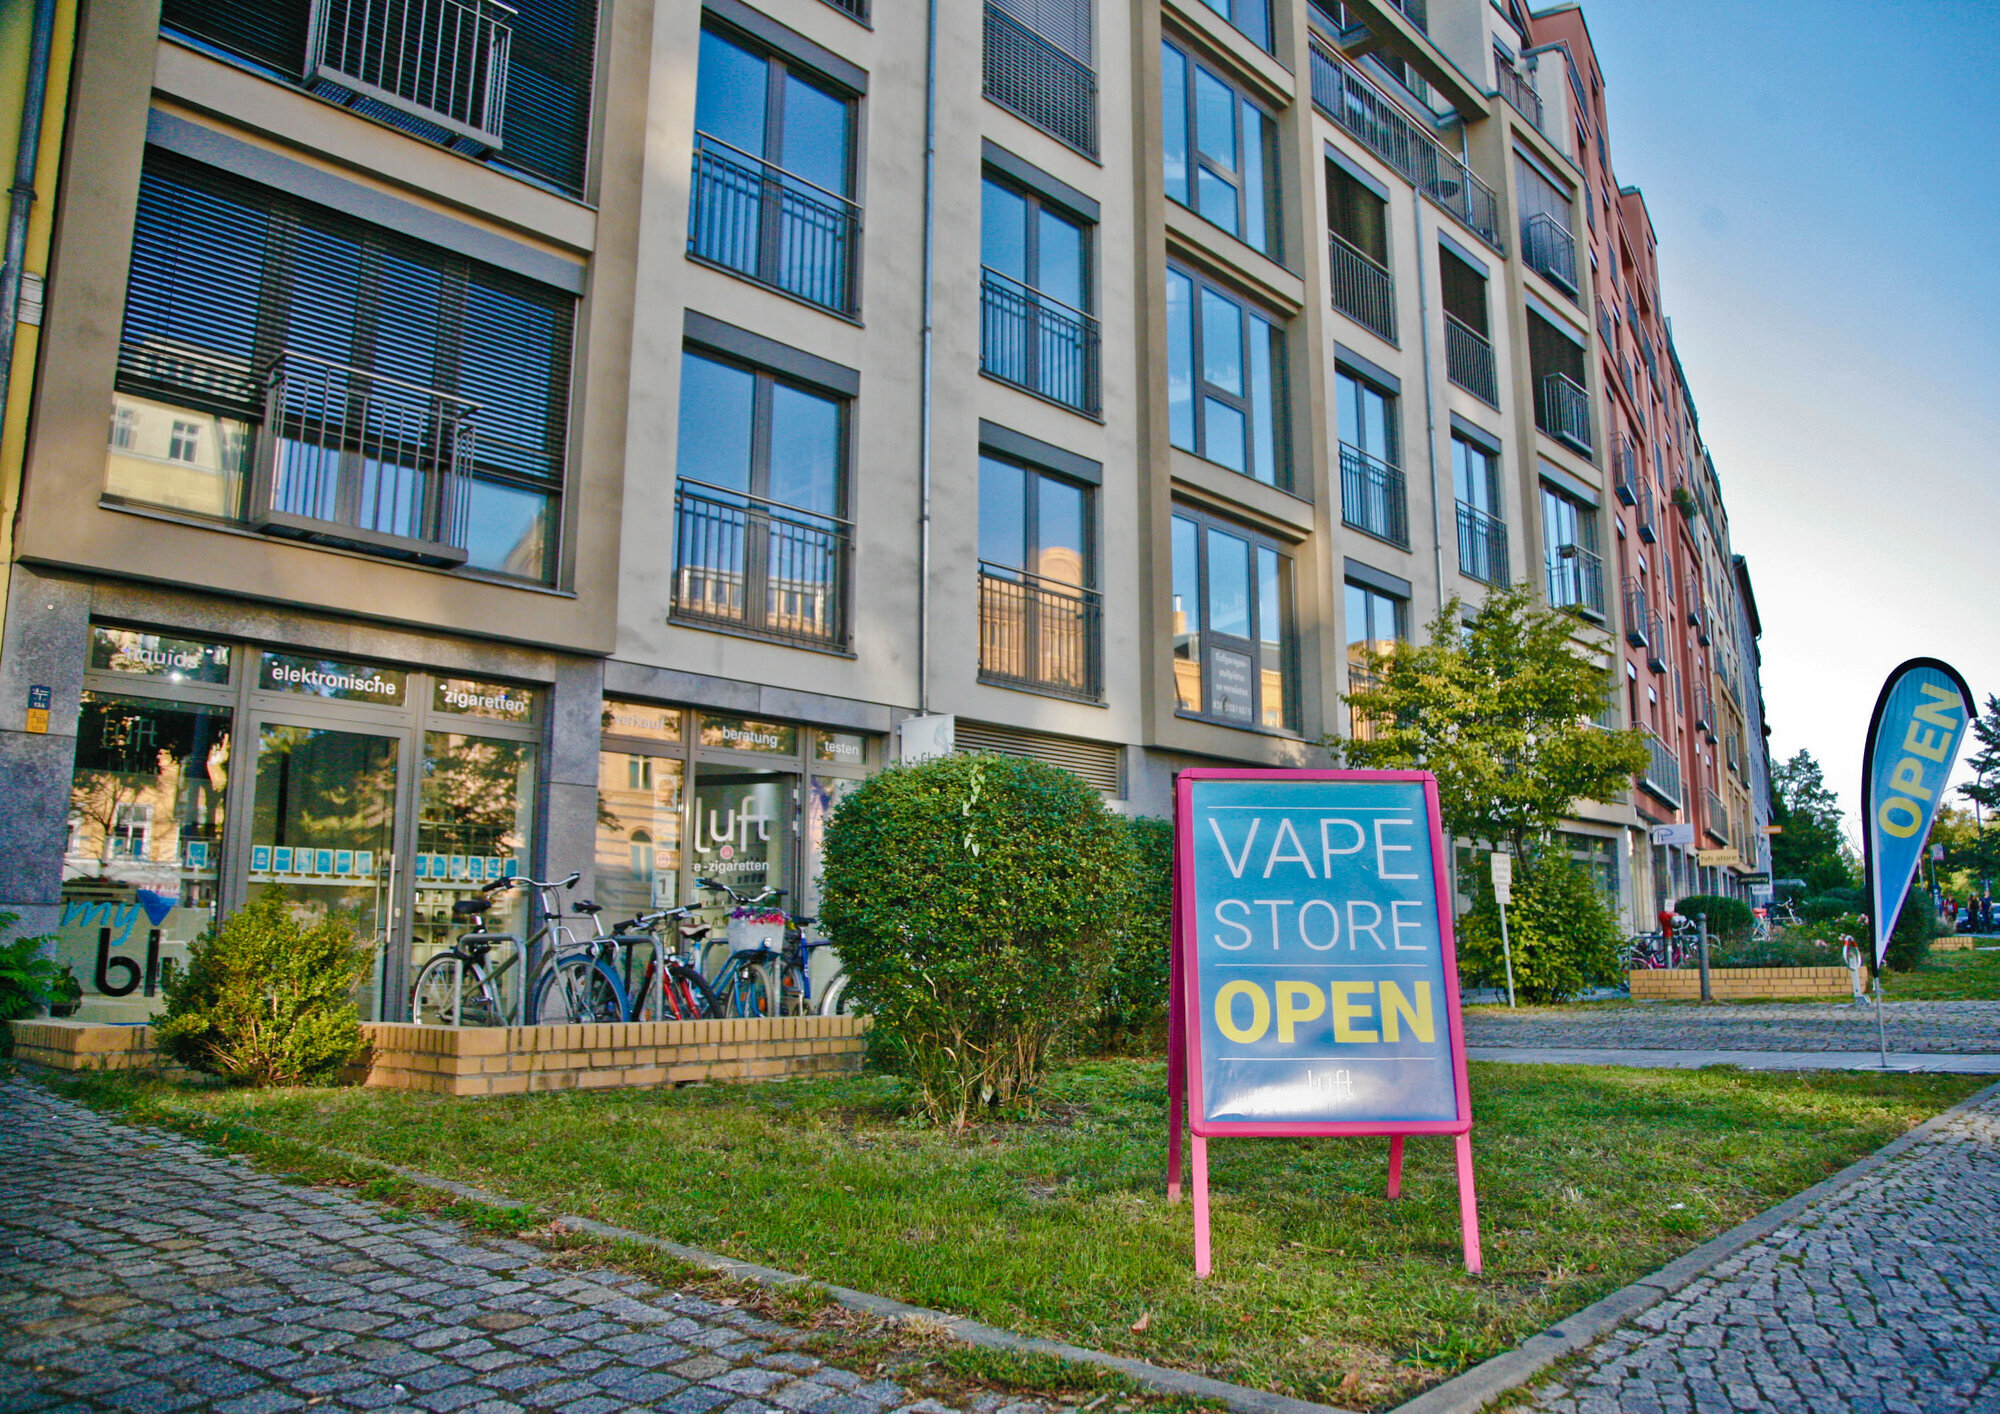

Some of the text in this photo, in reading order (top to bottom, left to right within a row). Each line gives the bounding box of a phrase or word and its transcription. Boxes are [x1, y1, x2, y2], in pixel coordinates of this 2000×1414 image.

[125, 646, 199, 669] liquids
[271, 664, 397, 695] elektronische
[444, 689, 525, 713] zigaretten
[613, 713, 667, 731] verkauf
[722, 725, 779, 748] beratung
[824, 741, 860, 756] testen
[1877, 682, 1961, 838] OPEN
[1207, 817, 1420, 880] VAPE
[60, 901, 142, 947] my
[1214, 899, 1427, 952] STORE
[1214, 979, 1436, 1044] OPEN
